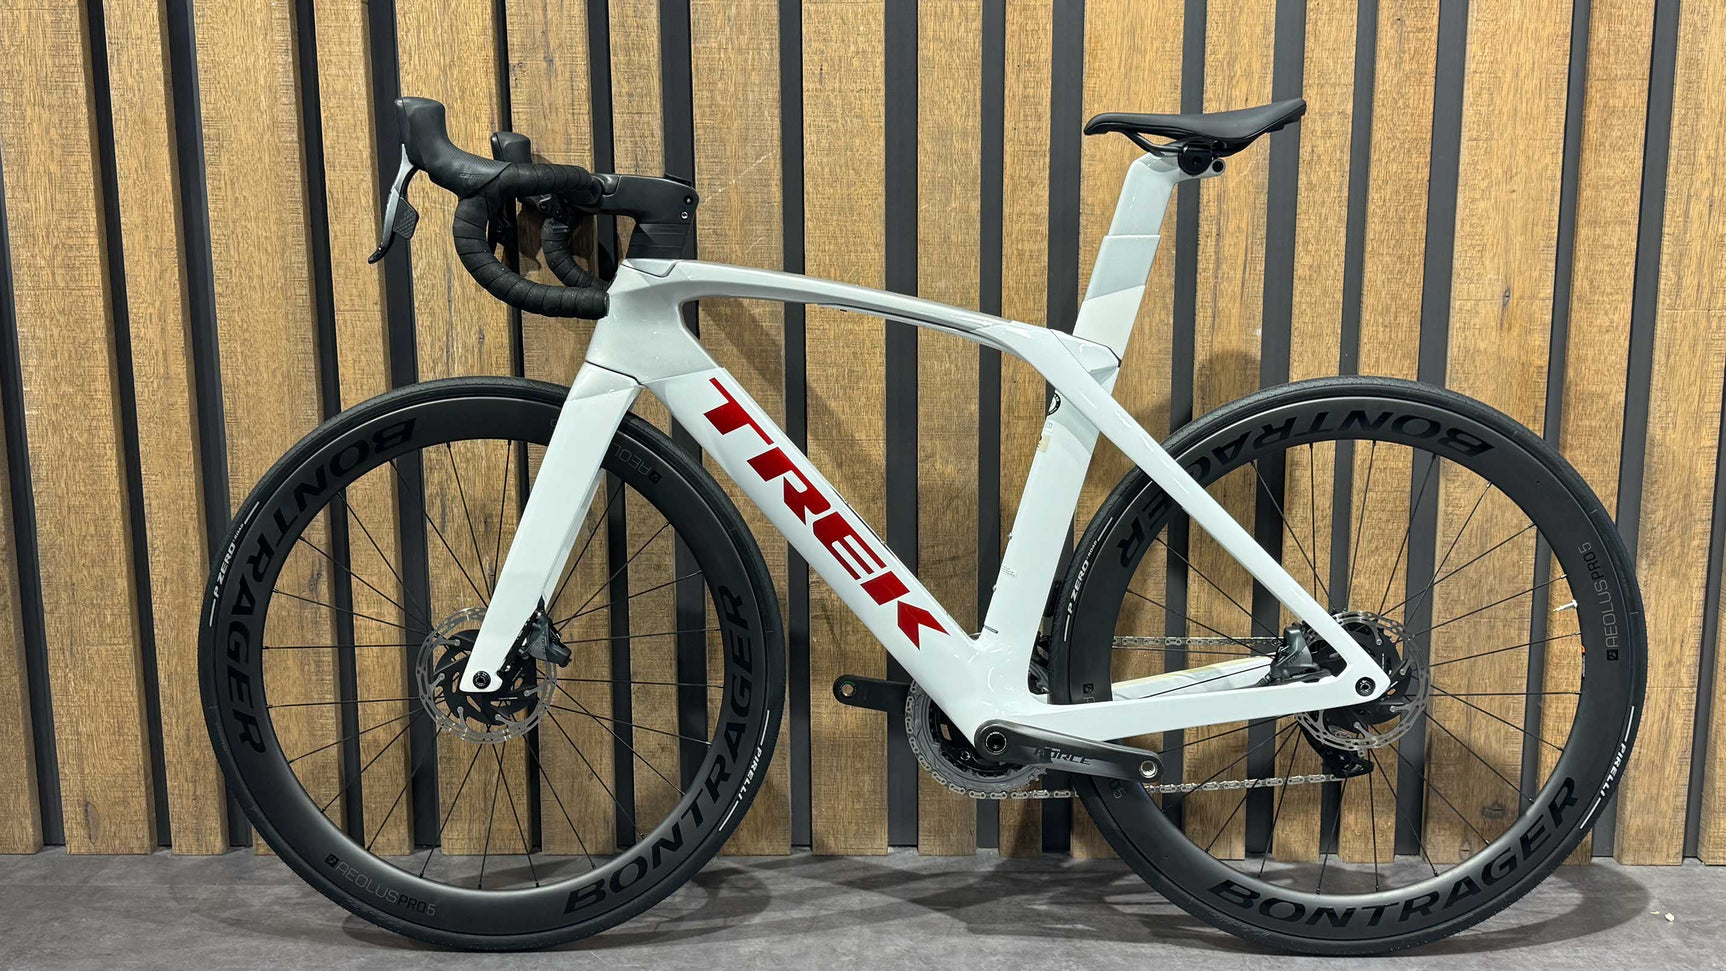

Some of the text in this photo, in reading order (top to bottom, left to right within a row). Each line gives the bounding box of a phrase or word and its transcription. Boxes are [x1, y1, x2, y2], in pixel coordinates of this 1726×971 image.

[226, 417, 416, 753] BONTRAGER
[703, 377, 951, 651] TREK
[563, 585, 755, 915] BONTRAGER
[738, 746, 762, 800] PIRELLI
[1207, 776, 1579, 929] BONTRAGER
[1600, 742, 1627, 797] PIRELLI
